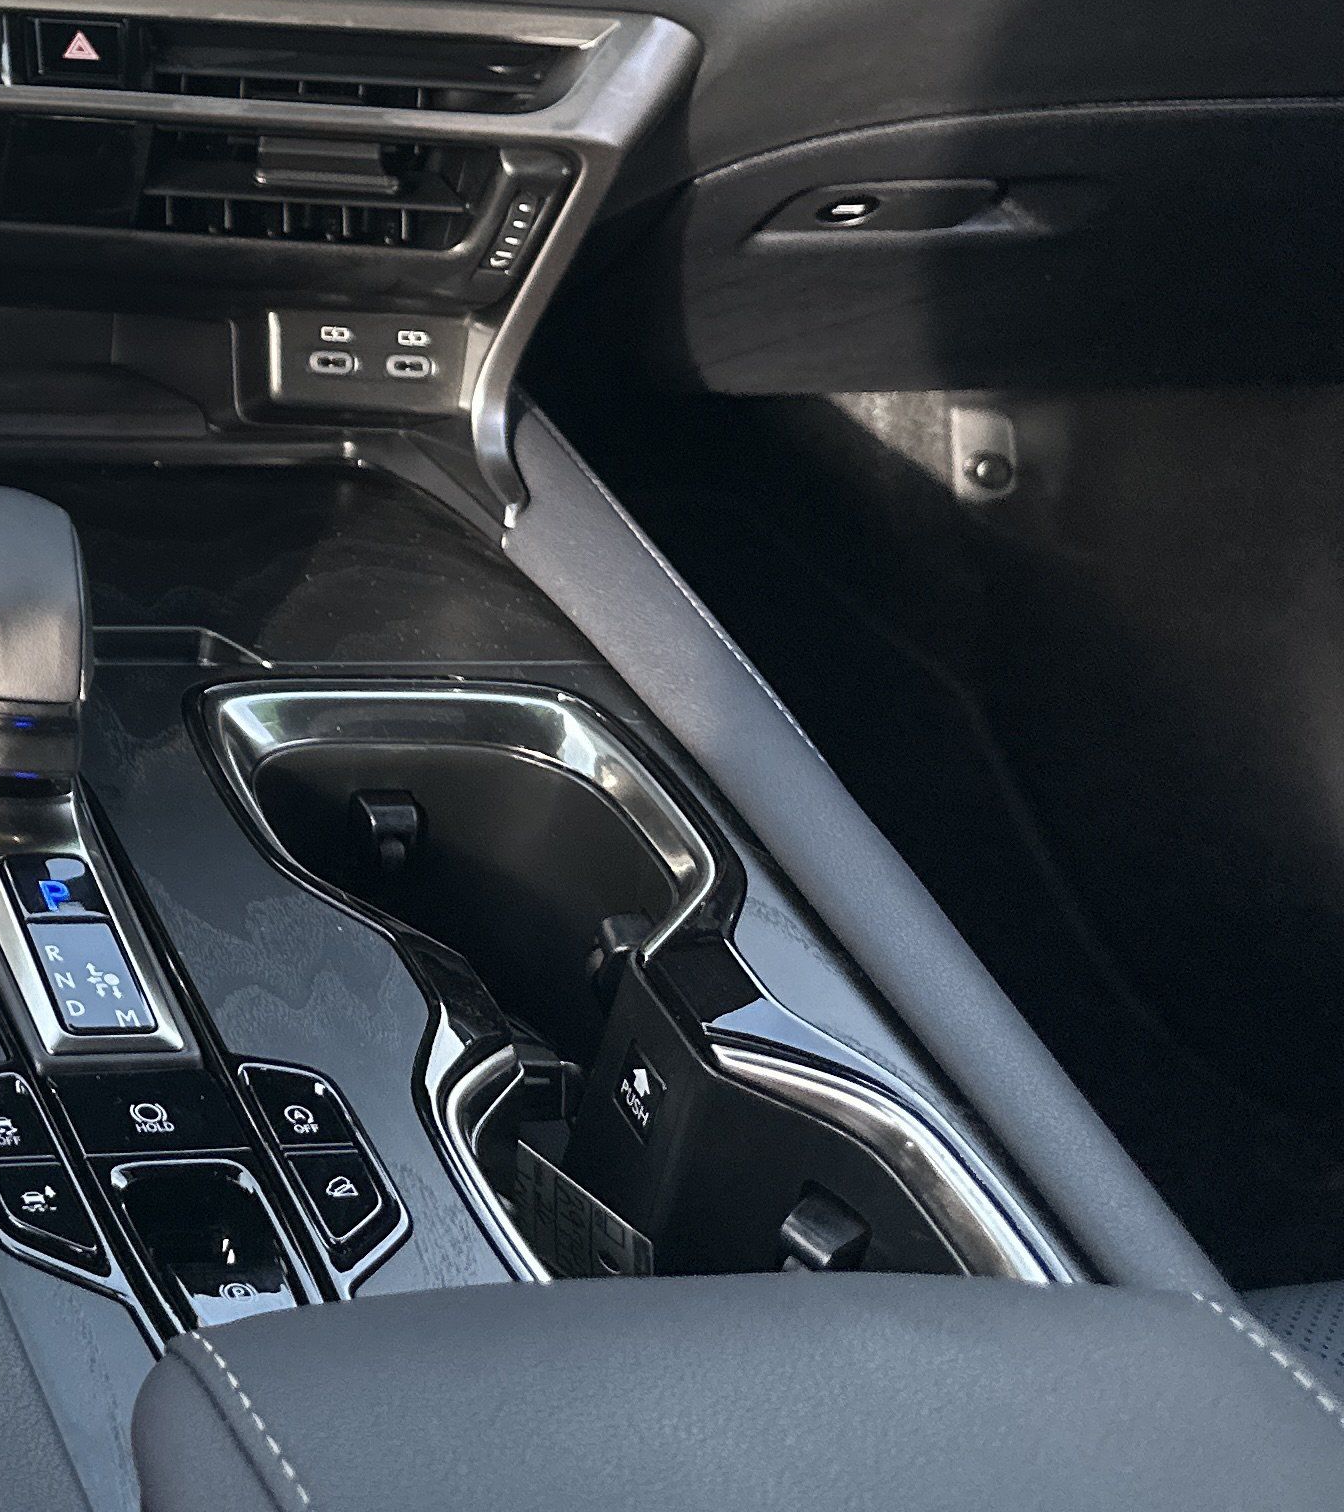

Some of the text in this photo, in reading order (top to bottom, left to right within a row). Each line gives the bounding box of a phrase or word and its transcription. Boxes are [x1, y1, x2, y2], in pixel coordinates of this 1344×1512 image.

[38, 879, 69, 911] P
[45, 944, 63, 964] R
[54, 971, 76, 990] N
[66, 999, 87, 1018] D
[118, 1010, 141, 1028] M
[620, 1078, 650, 1126] PUSH
[135, 1119, 175, 1134] HOLD
[293, 1122, 319, 1135] OFF
